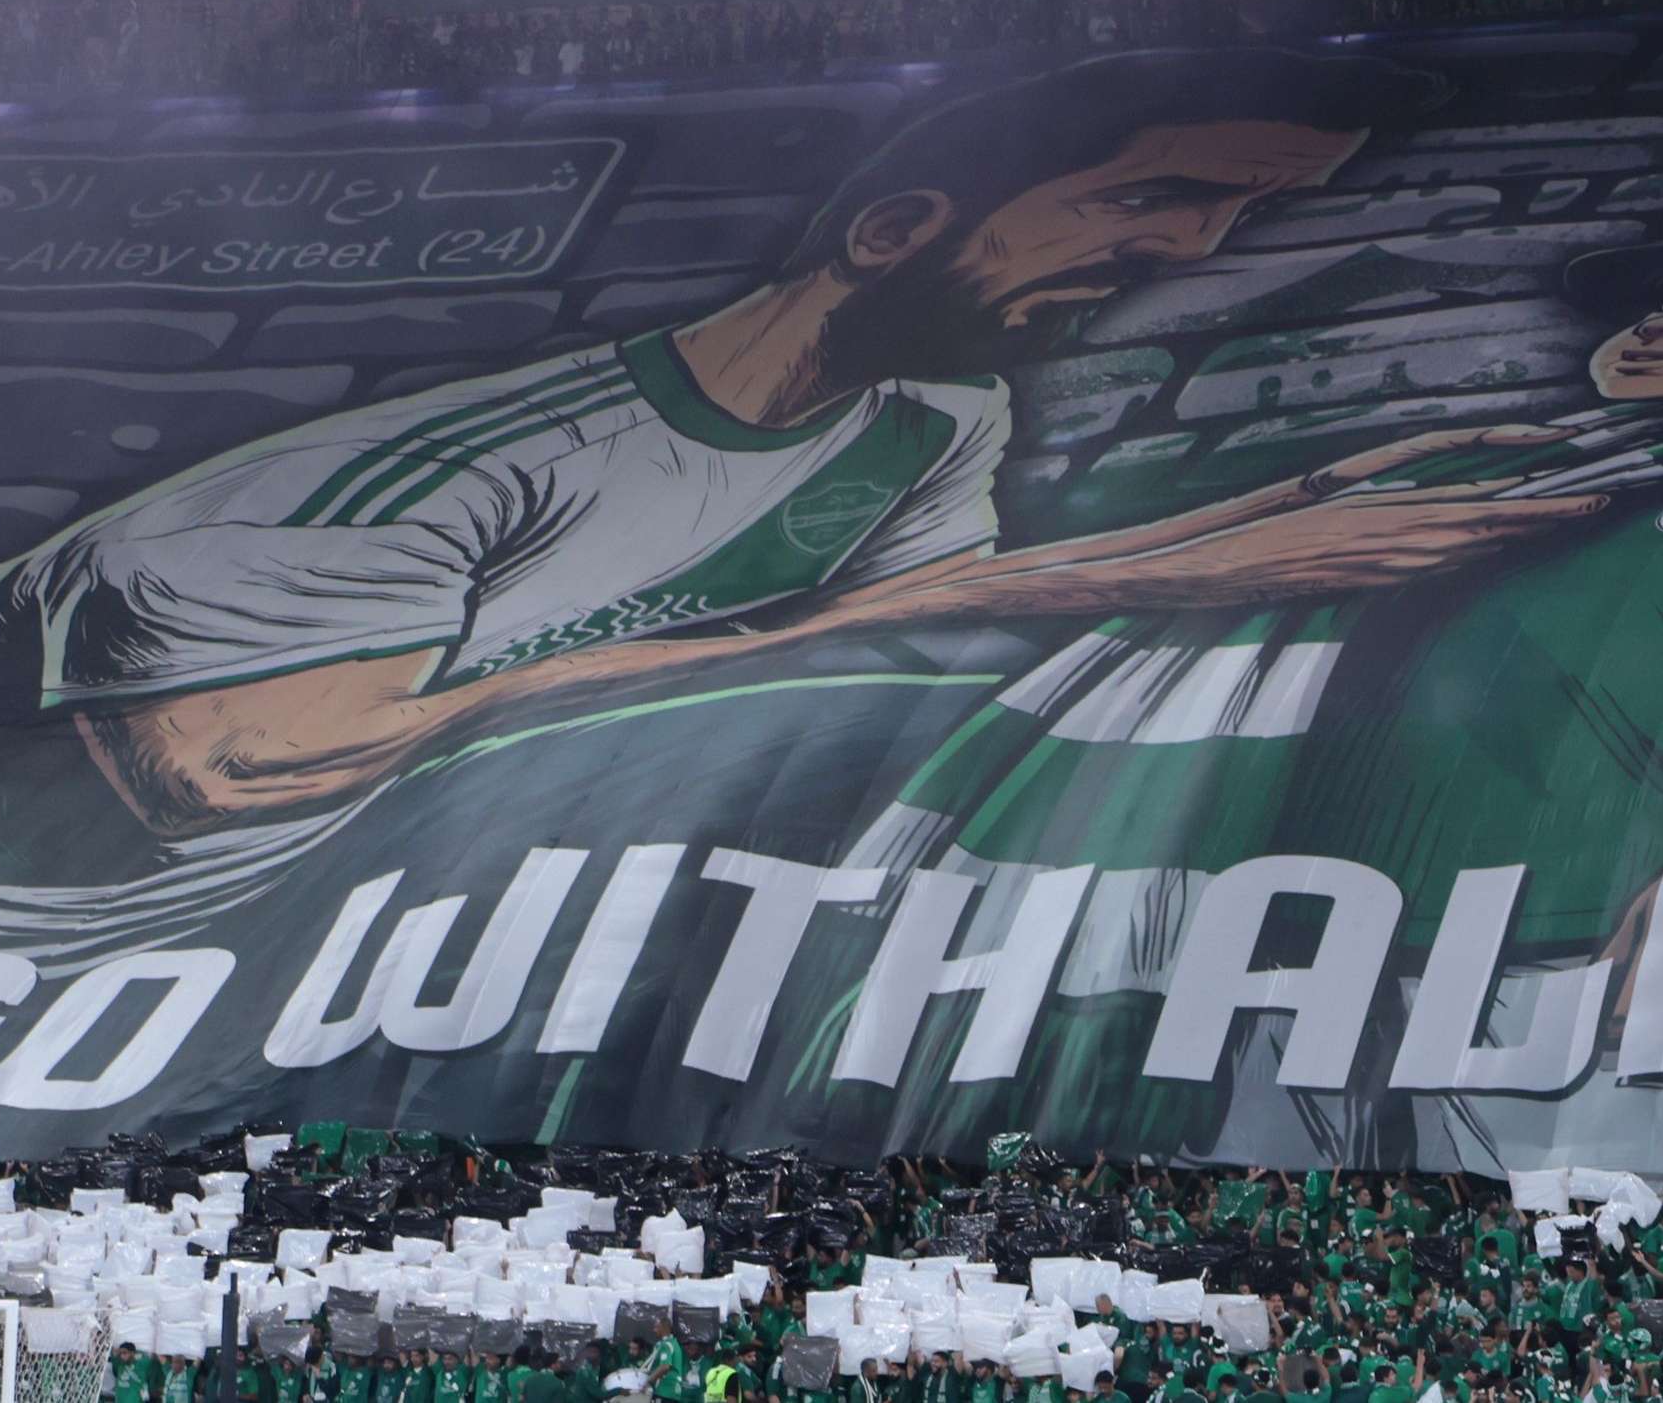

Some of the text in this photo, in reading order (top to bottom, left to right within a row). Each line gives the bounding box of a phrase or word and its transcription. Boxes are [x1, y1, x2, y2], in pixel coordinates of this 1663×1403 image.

[129, 167, 327, 227] النادي
[325, 160, 580, 225] شارع
[201, 235, 393, 274] Street
[417, 225, 546, 272] (24)
[263, 842, 1095, 1088] WITH
